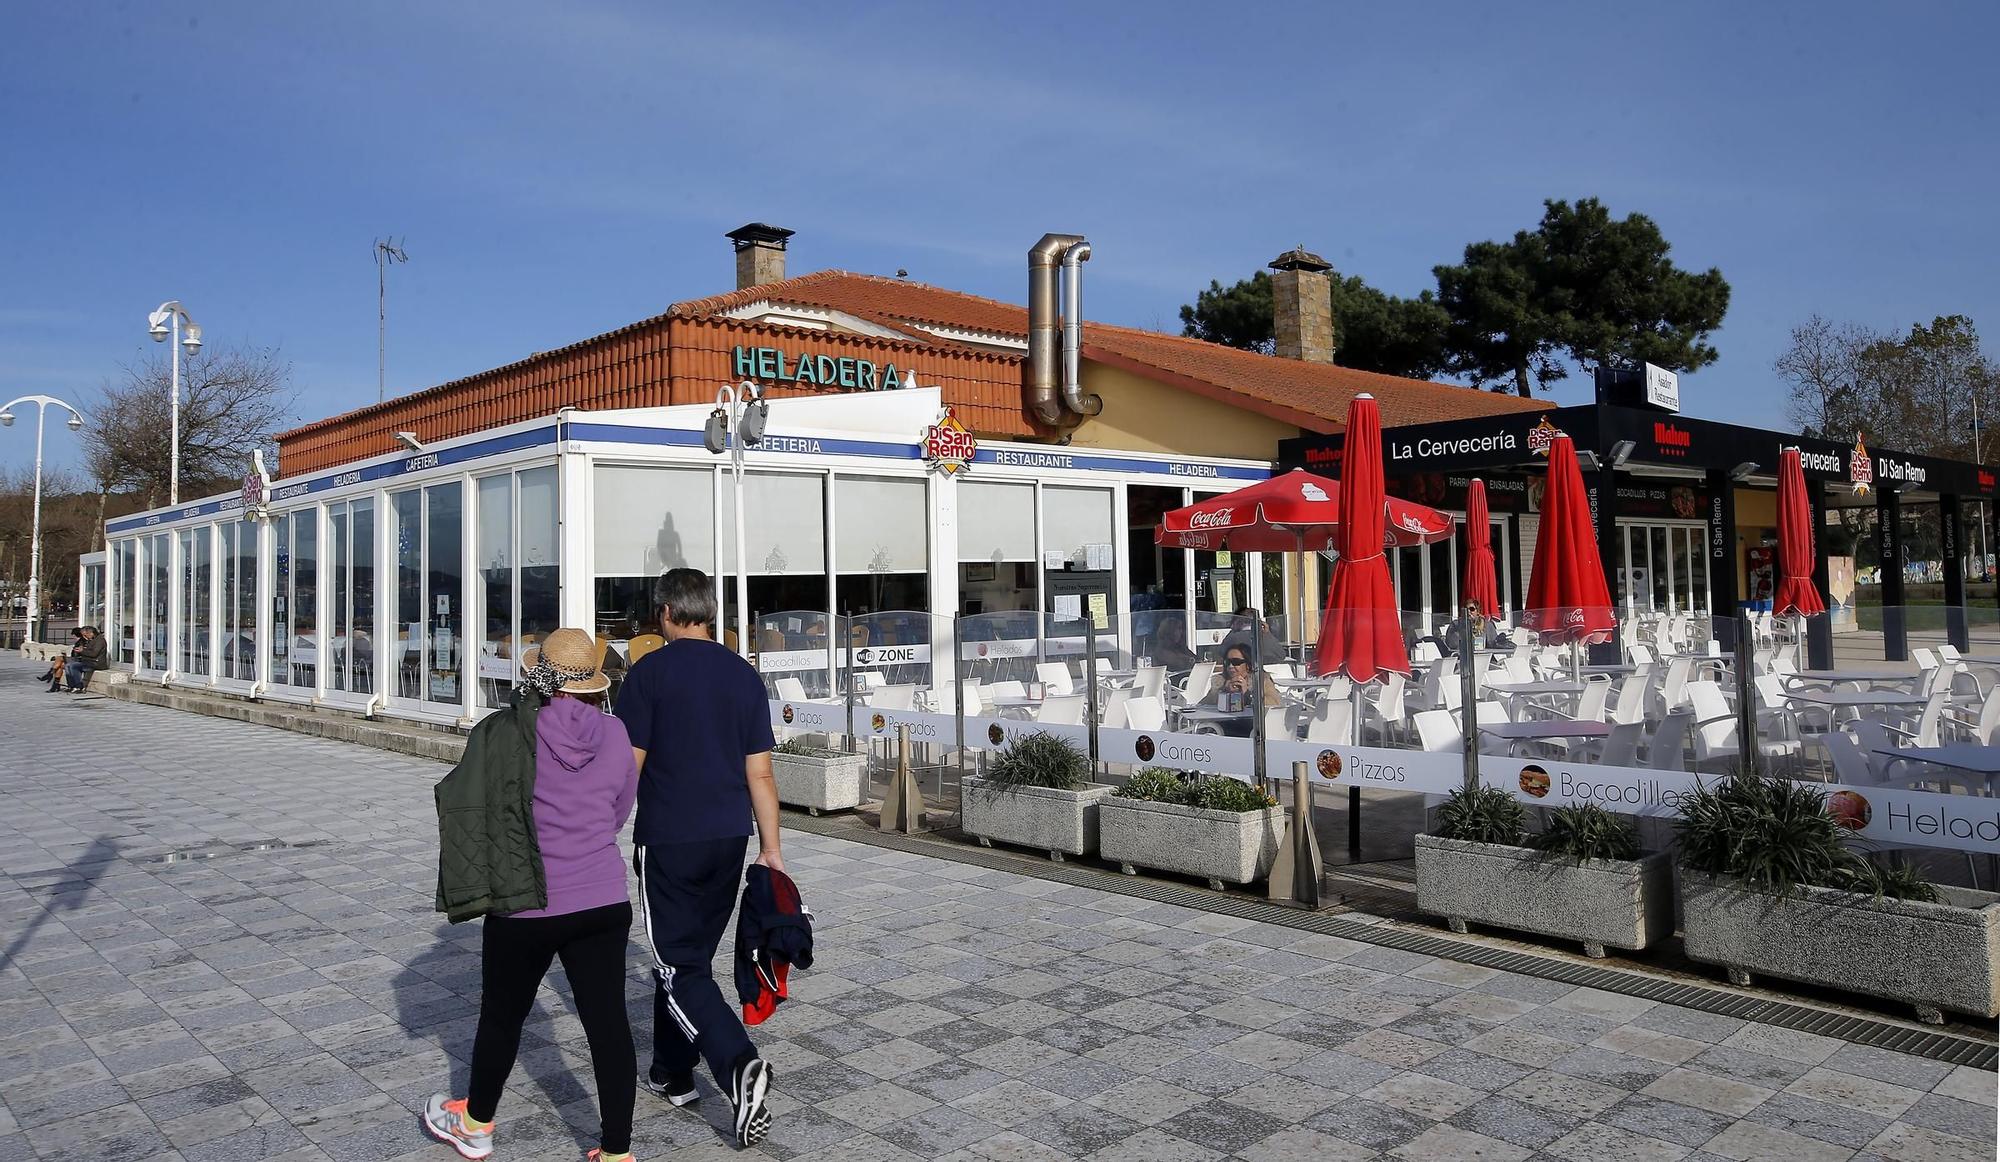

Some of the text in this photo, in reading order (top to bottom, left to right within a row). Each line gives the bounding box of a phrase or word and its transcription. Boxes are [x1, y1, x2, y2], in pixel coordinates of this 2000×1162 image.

[1654, 422, 1690, 447] Mahou
[928, 439, 975, 458] Remo
[1392, 430, 1516, 459] La Cervecería
[405, 453, 439, 471] CAFETERIA
[995, 451, 1073, 468] RESTAURANTE
[333, 471, 361, 487] HELADERIA
[1169, 463, 1218, 478] HELADERIA
[1851, 462, 1872, 482] Remo
[1879, 457, 1926, 482] Di San Remo
[279, 483, 309, 499] RESTAURANTE
[1489, 479, 1524, 491] ENSALADAS
[1189, 507, 1235, 529] Coca-Cola
[1712, 497, 1723, 558] Di San Remo
[878, 648, 914, 662] ZONE
[990, 645, 1022, 655] Helados
[762, 656, 811, 669] Bocadillos
[796, 707, 823, 728] Tapas
[1159, 739, 1212, 763] Carnes
[1350, 755, 1406, 784] Pizzas
